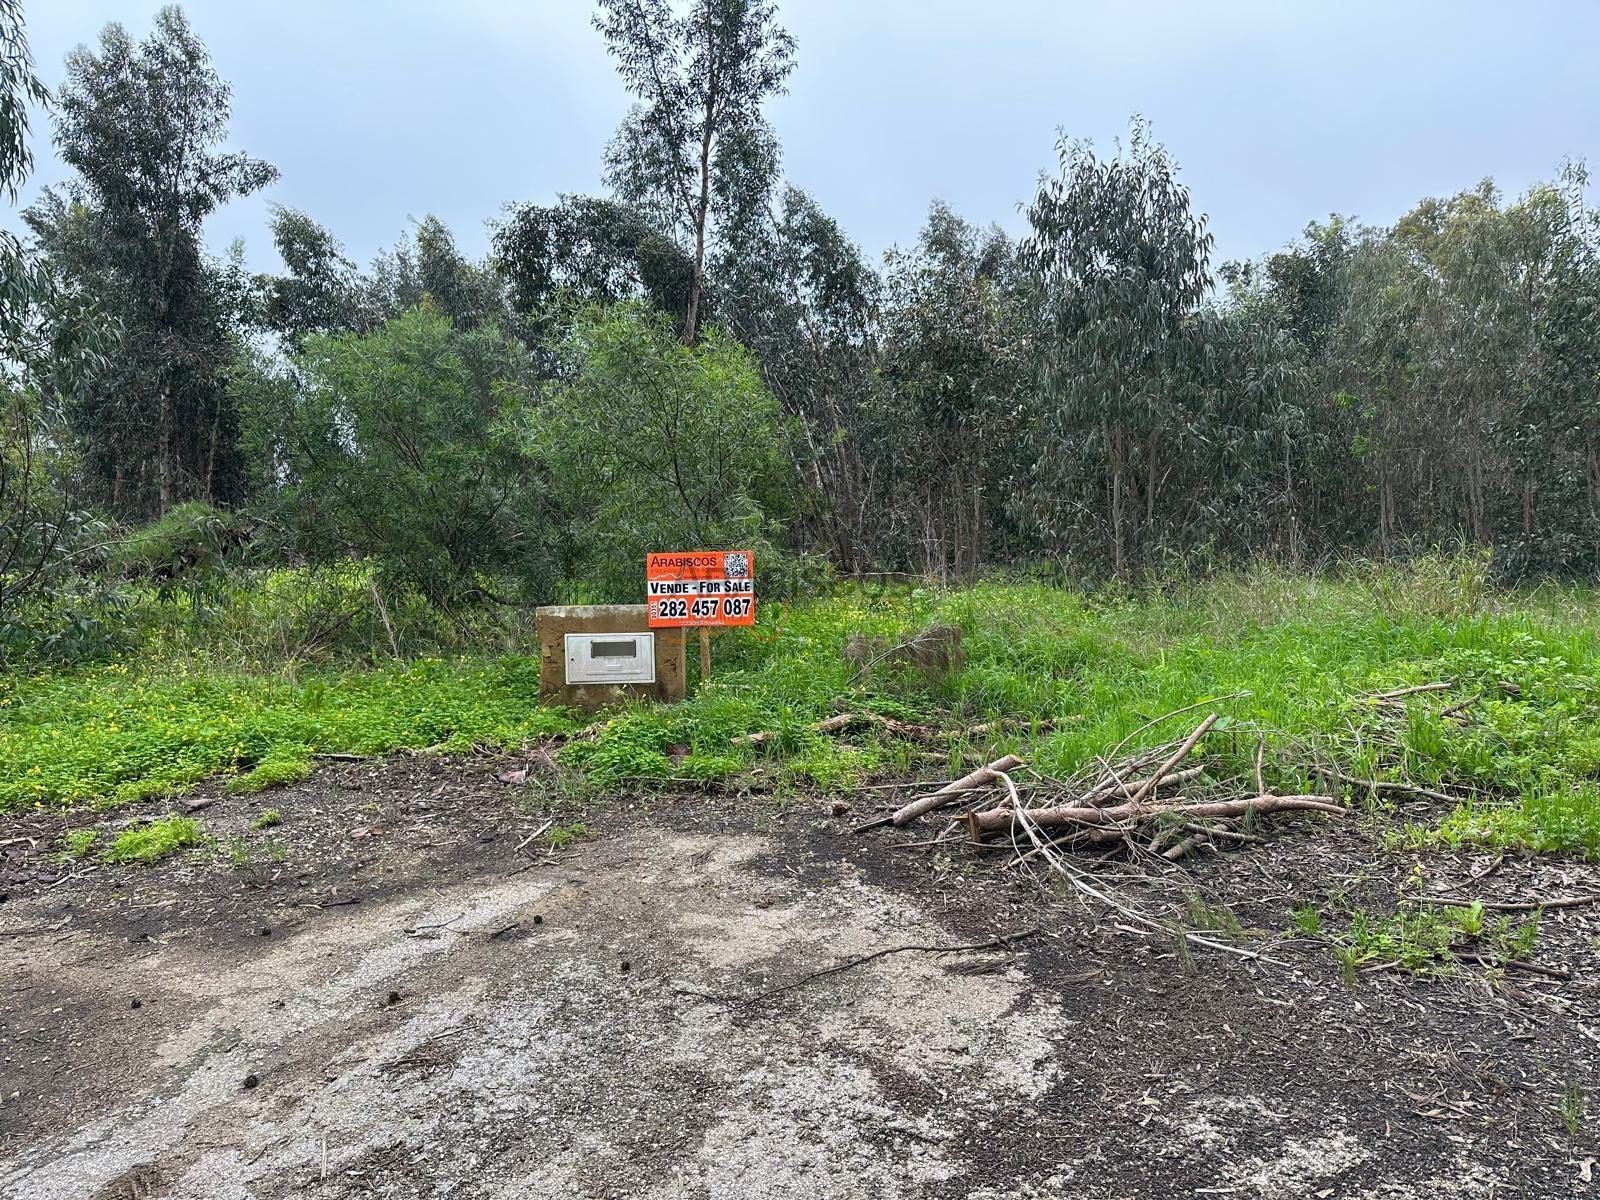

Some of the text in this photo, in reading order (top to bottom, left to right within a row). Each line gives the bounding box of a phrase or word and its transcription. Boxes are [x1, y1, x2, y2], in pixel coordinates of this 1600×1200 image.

[650, 555, 717, 567] ARABISCOS
[650, 582, 689, 594] VENDE
[699, 581, 721, 593] FOR
[724, 580, 751, 592] SALE
[659, 598, 751, 617] 282 457 087
